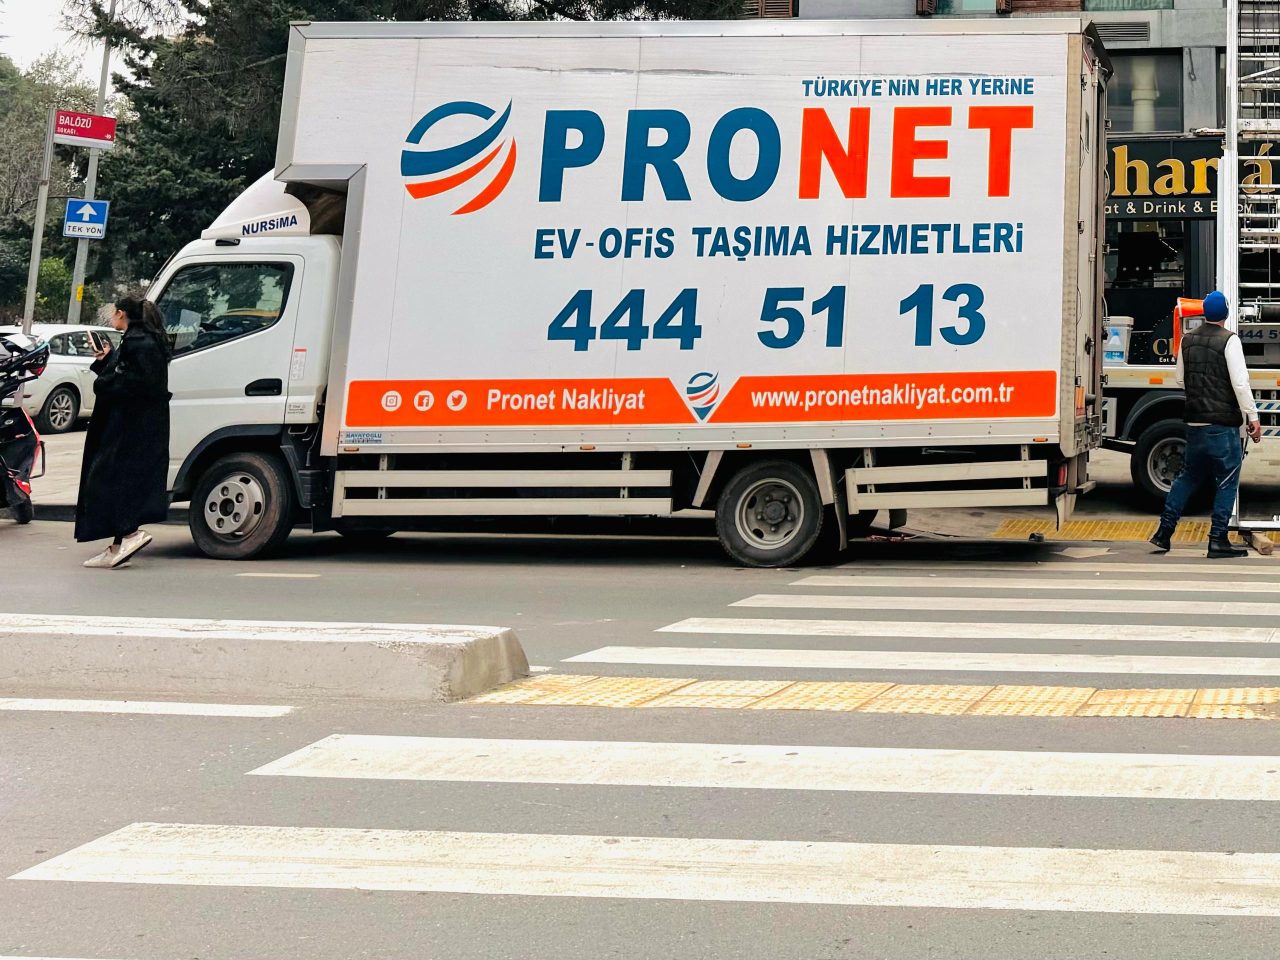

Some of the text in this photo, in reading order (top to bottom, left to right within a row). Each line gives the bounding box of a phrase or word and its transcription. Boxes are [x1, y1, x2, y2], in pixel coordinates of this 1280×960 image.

[925, 79, 963, 96] HER
[58, 115, 92, 129] BALÖZÜ
[538, 105, 1034, 203] PRONET
[1126, 201, 1137, 214] &
[1144, 201, 1186, 214] Drink
[1193, 200, 1204, 213] &
[691, 225, 812, 262] TAŞIMA
[547, 283, 986, 352] 444 51 13
[487, 387, 645, 415] Pronet Nakliyat
[751, 383, 1014, 411] www.pronetnakliyat.com.tr
